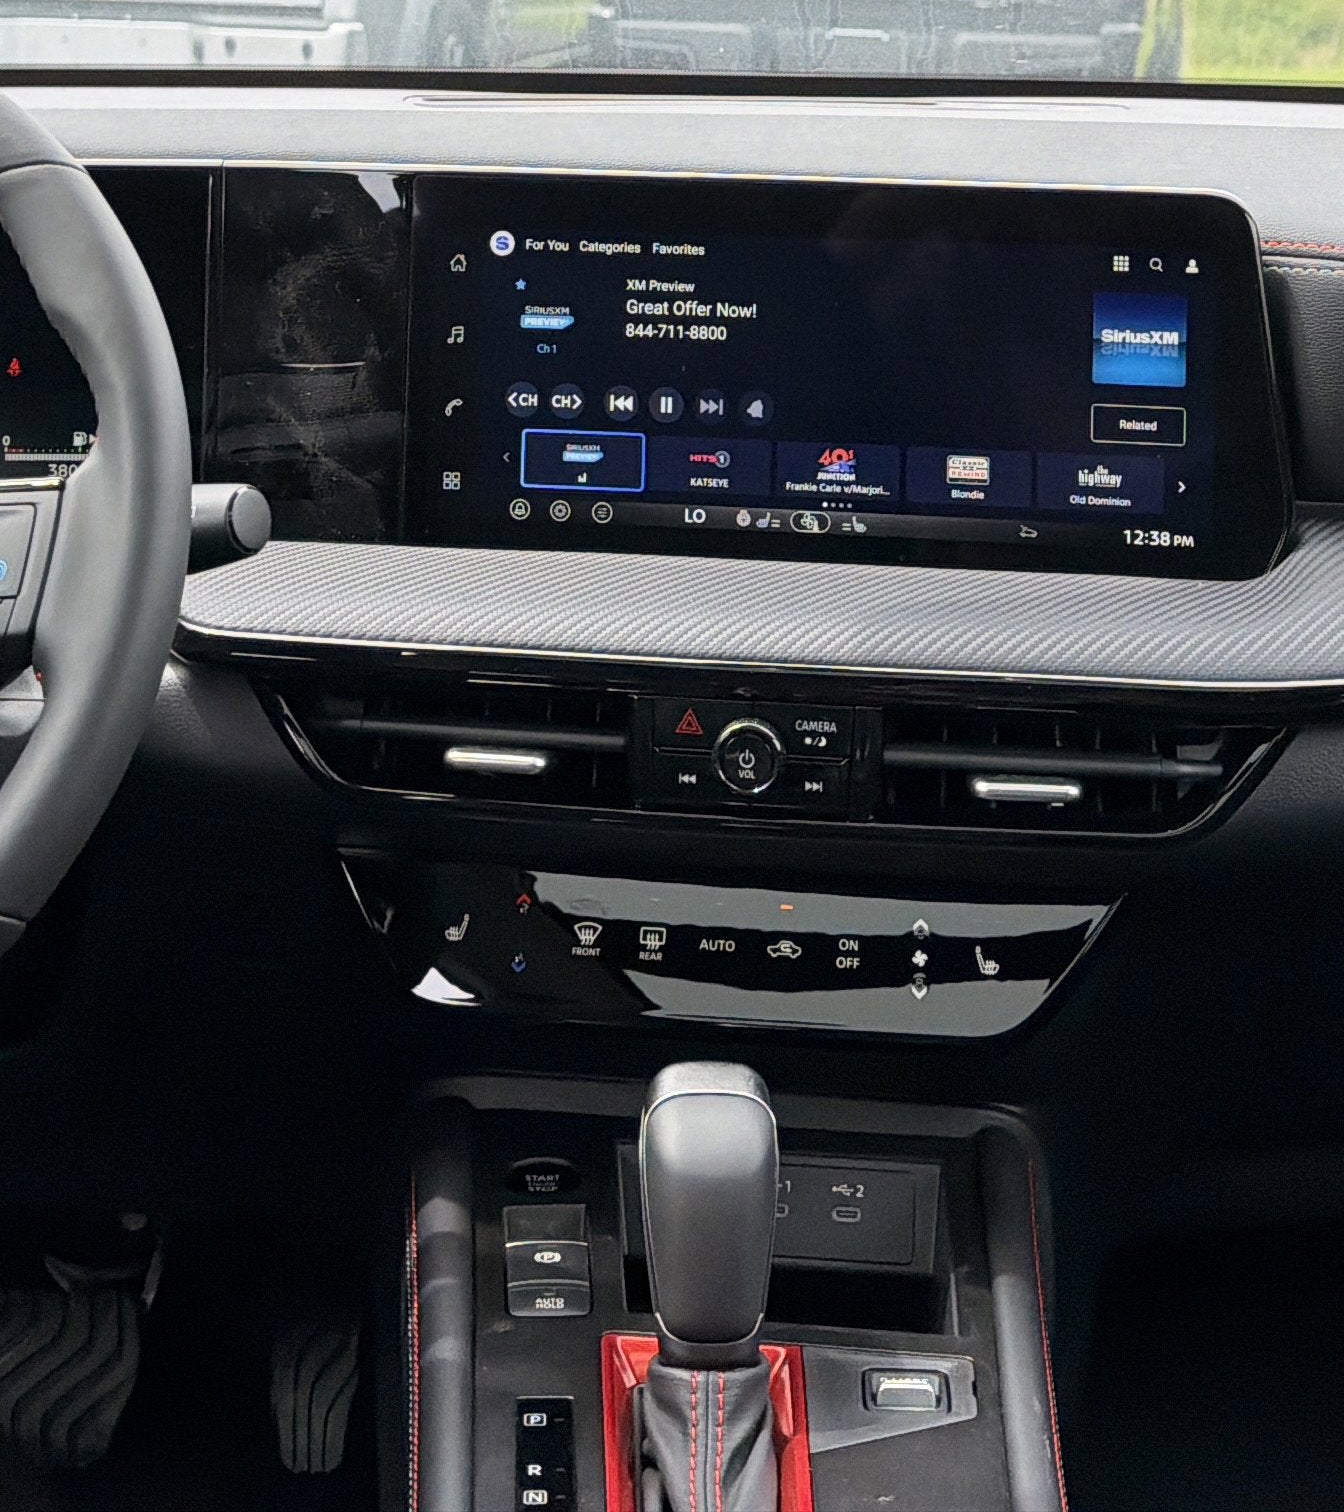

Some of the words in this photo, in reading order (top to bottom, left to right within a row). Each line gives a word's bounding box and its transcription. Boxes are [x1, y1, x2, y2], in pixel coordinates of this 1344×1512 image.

[525, 238, 545, 251] For
[547, 239, 570, 252] You
[579, 240, 641, 255] Categories
[652, 242, 706, 256] Favorites
[626, 279, 646, 292] XM
[648, 280, 695, 293] Preview
[626, 299, 670, 316] Great
[672, 300, 712, 317] Offer
[716, 302, 757, 319] Now!
[625, 323, 727, 341] 844-711-8800
[1100, 328, 1179, 346] SiriusXM
[536, 343, 551, 354] Ch
[1119, 419, 1158, 432] Related
[2, 435, 11, 446] 0
[690, 477, 729, 488] KATSEYE
[816, 472, 856, 481] JUNCTION
[1078, 469, 1123, 488] highway
[785, 481, 818, 493] Frankie
[819, 482, 842, 493] Carle
[951, 488, 985, 500] Blondie
[1069, 494, 1086, 506] Old
[1087, 495, 1131, 507] Dominion
[684, 508, 706, 524] LO
[1123, 529, 1171, 548] 12:38
[1173, 535, 1195, 548] PM
[795, 719, 837, 734] CAMERA
[738, 769, 757, 780] VOL
[571, 946, 601, 957] FRONT
[639, 951, 663, 961] REAR
[699, 939, 736, 952] AUTO
[838, 939, 859, 951] ON
[836, 957, 860, 969] OFF
[525, 1174, 560, 1182] START
[784, 1180, 793, 1193] 1
[856, 1185, 865, 1198] 2
[530, 1415, 542, 1425] P
[527, 1464, 543, 1476] R
[528, 1491, 544, 1503] N
